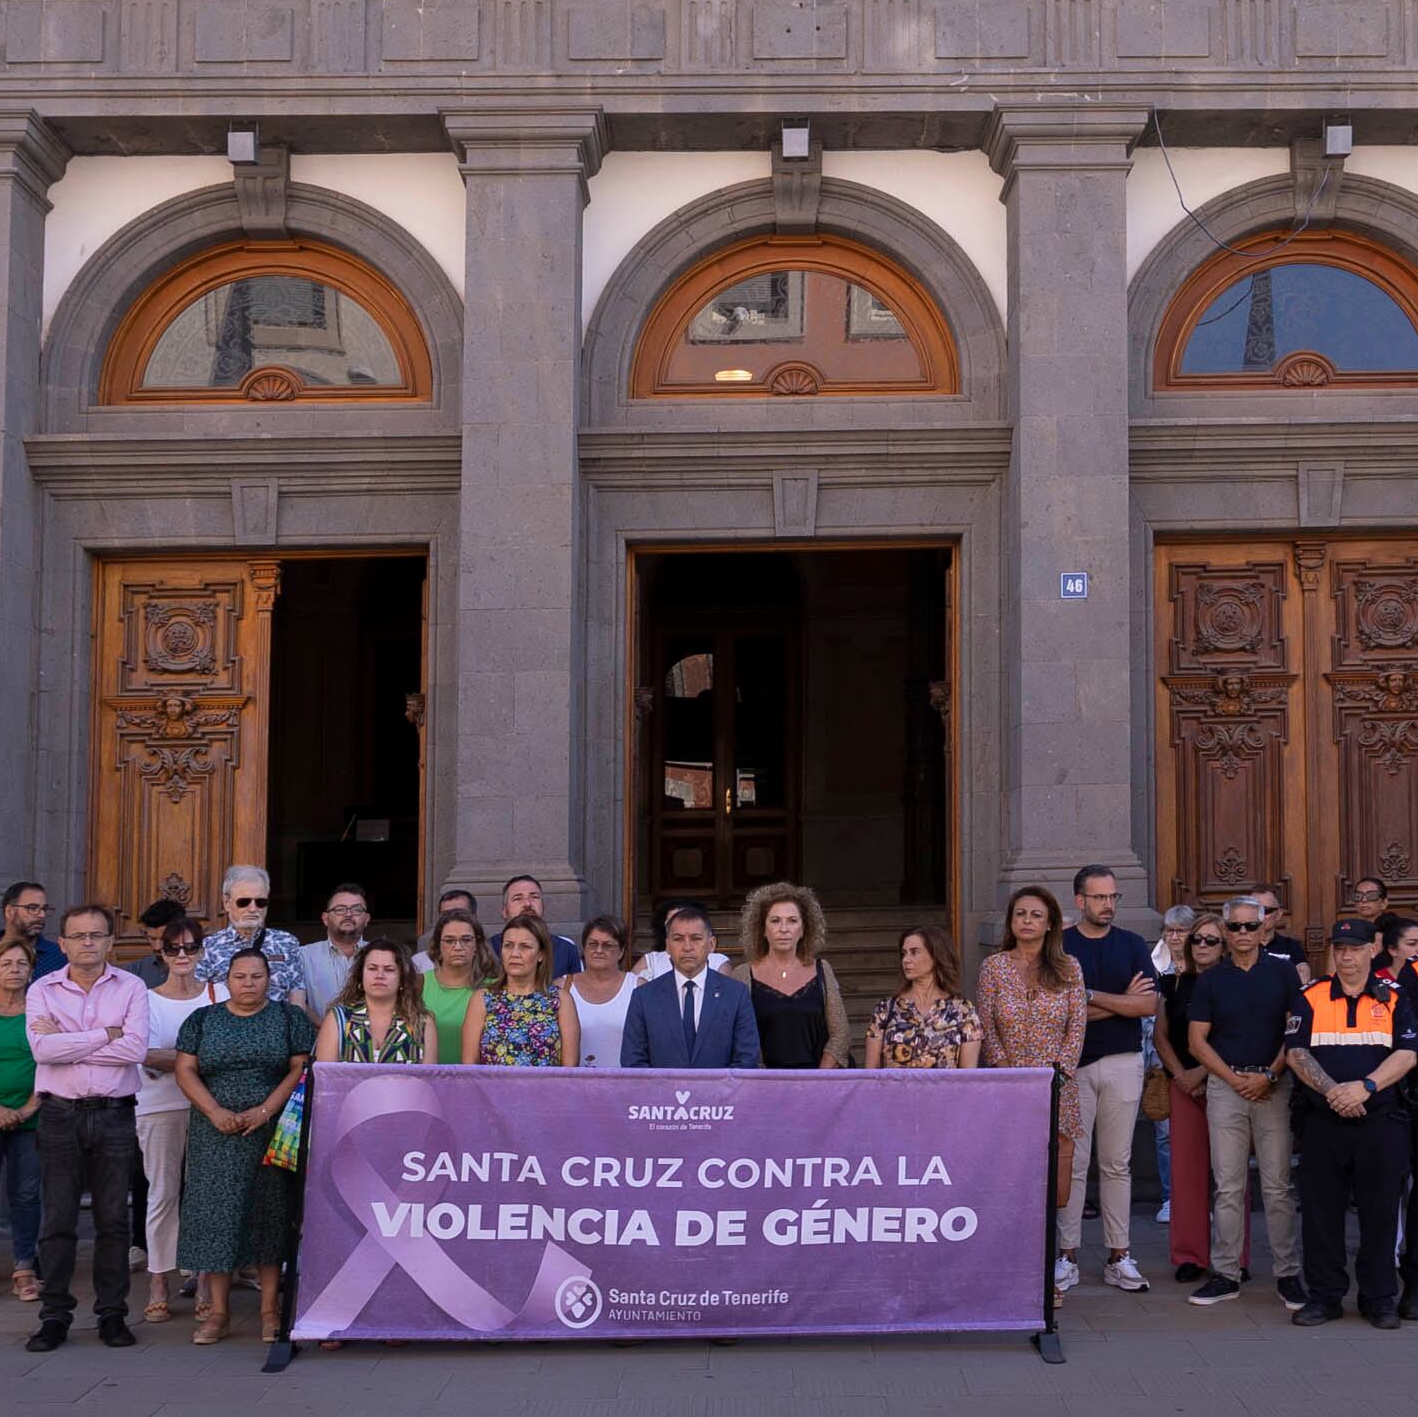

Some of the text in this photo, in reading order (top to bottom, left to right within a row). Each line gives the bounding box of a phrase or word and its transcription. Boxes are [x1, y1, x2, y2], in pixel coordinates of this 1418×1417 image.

[1066, 579, 1083, 592] 46
[401, 1151, 952, 1188] SANTA CRUZ CONTRA LA
[371, 1199, 979, 1246] VIOLENCIA DE GÉNERO
[608, 1288, 789, 1306] Santa Cruz de Tenerife
[608, 1309, 701, 1321] AYUNTAMIENTO
